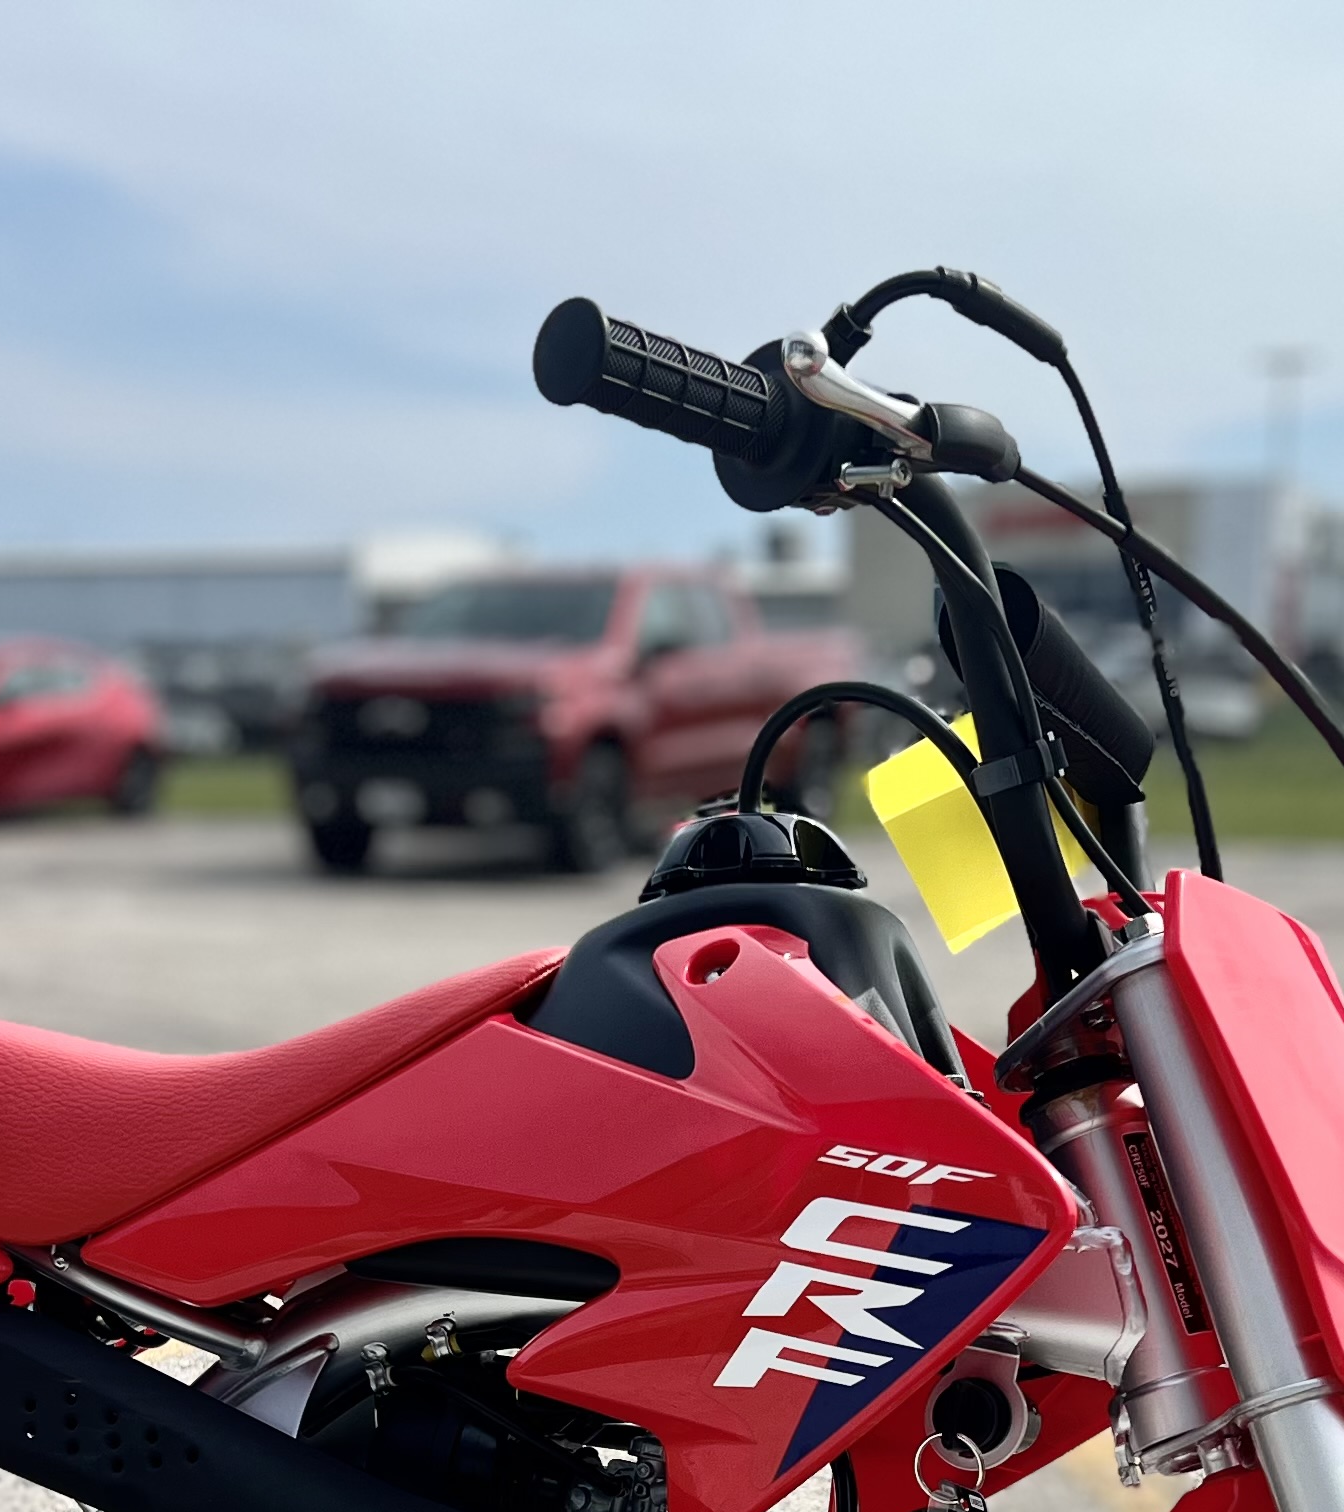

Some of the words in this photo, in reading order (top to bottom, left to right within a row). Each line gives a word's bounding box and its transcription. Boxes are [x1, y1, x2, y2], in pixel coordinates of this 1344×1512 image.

[817, 1144, 997, 1186] 50F
[1128, 1143, 1151, 1190] CRF50F
[1150, 1209, 1179, 1269] 2027
[1174, 1282, 1194, 1319] Model
[713, 1196, 972, 1388] CRF
